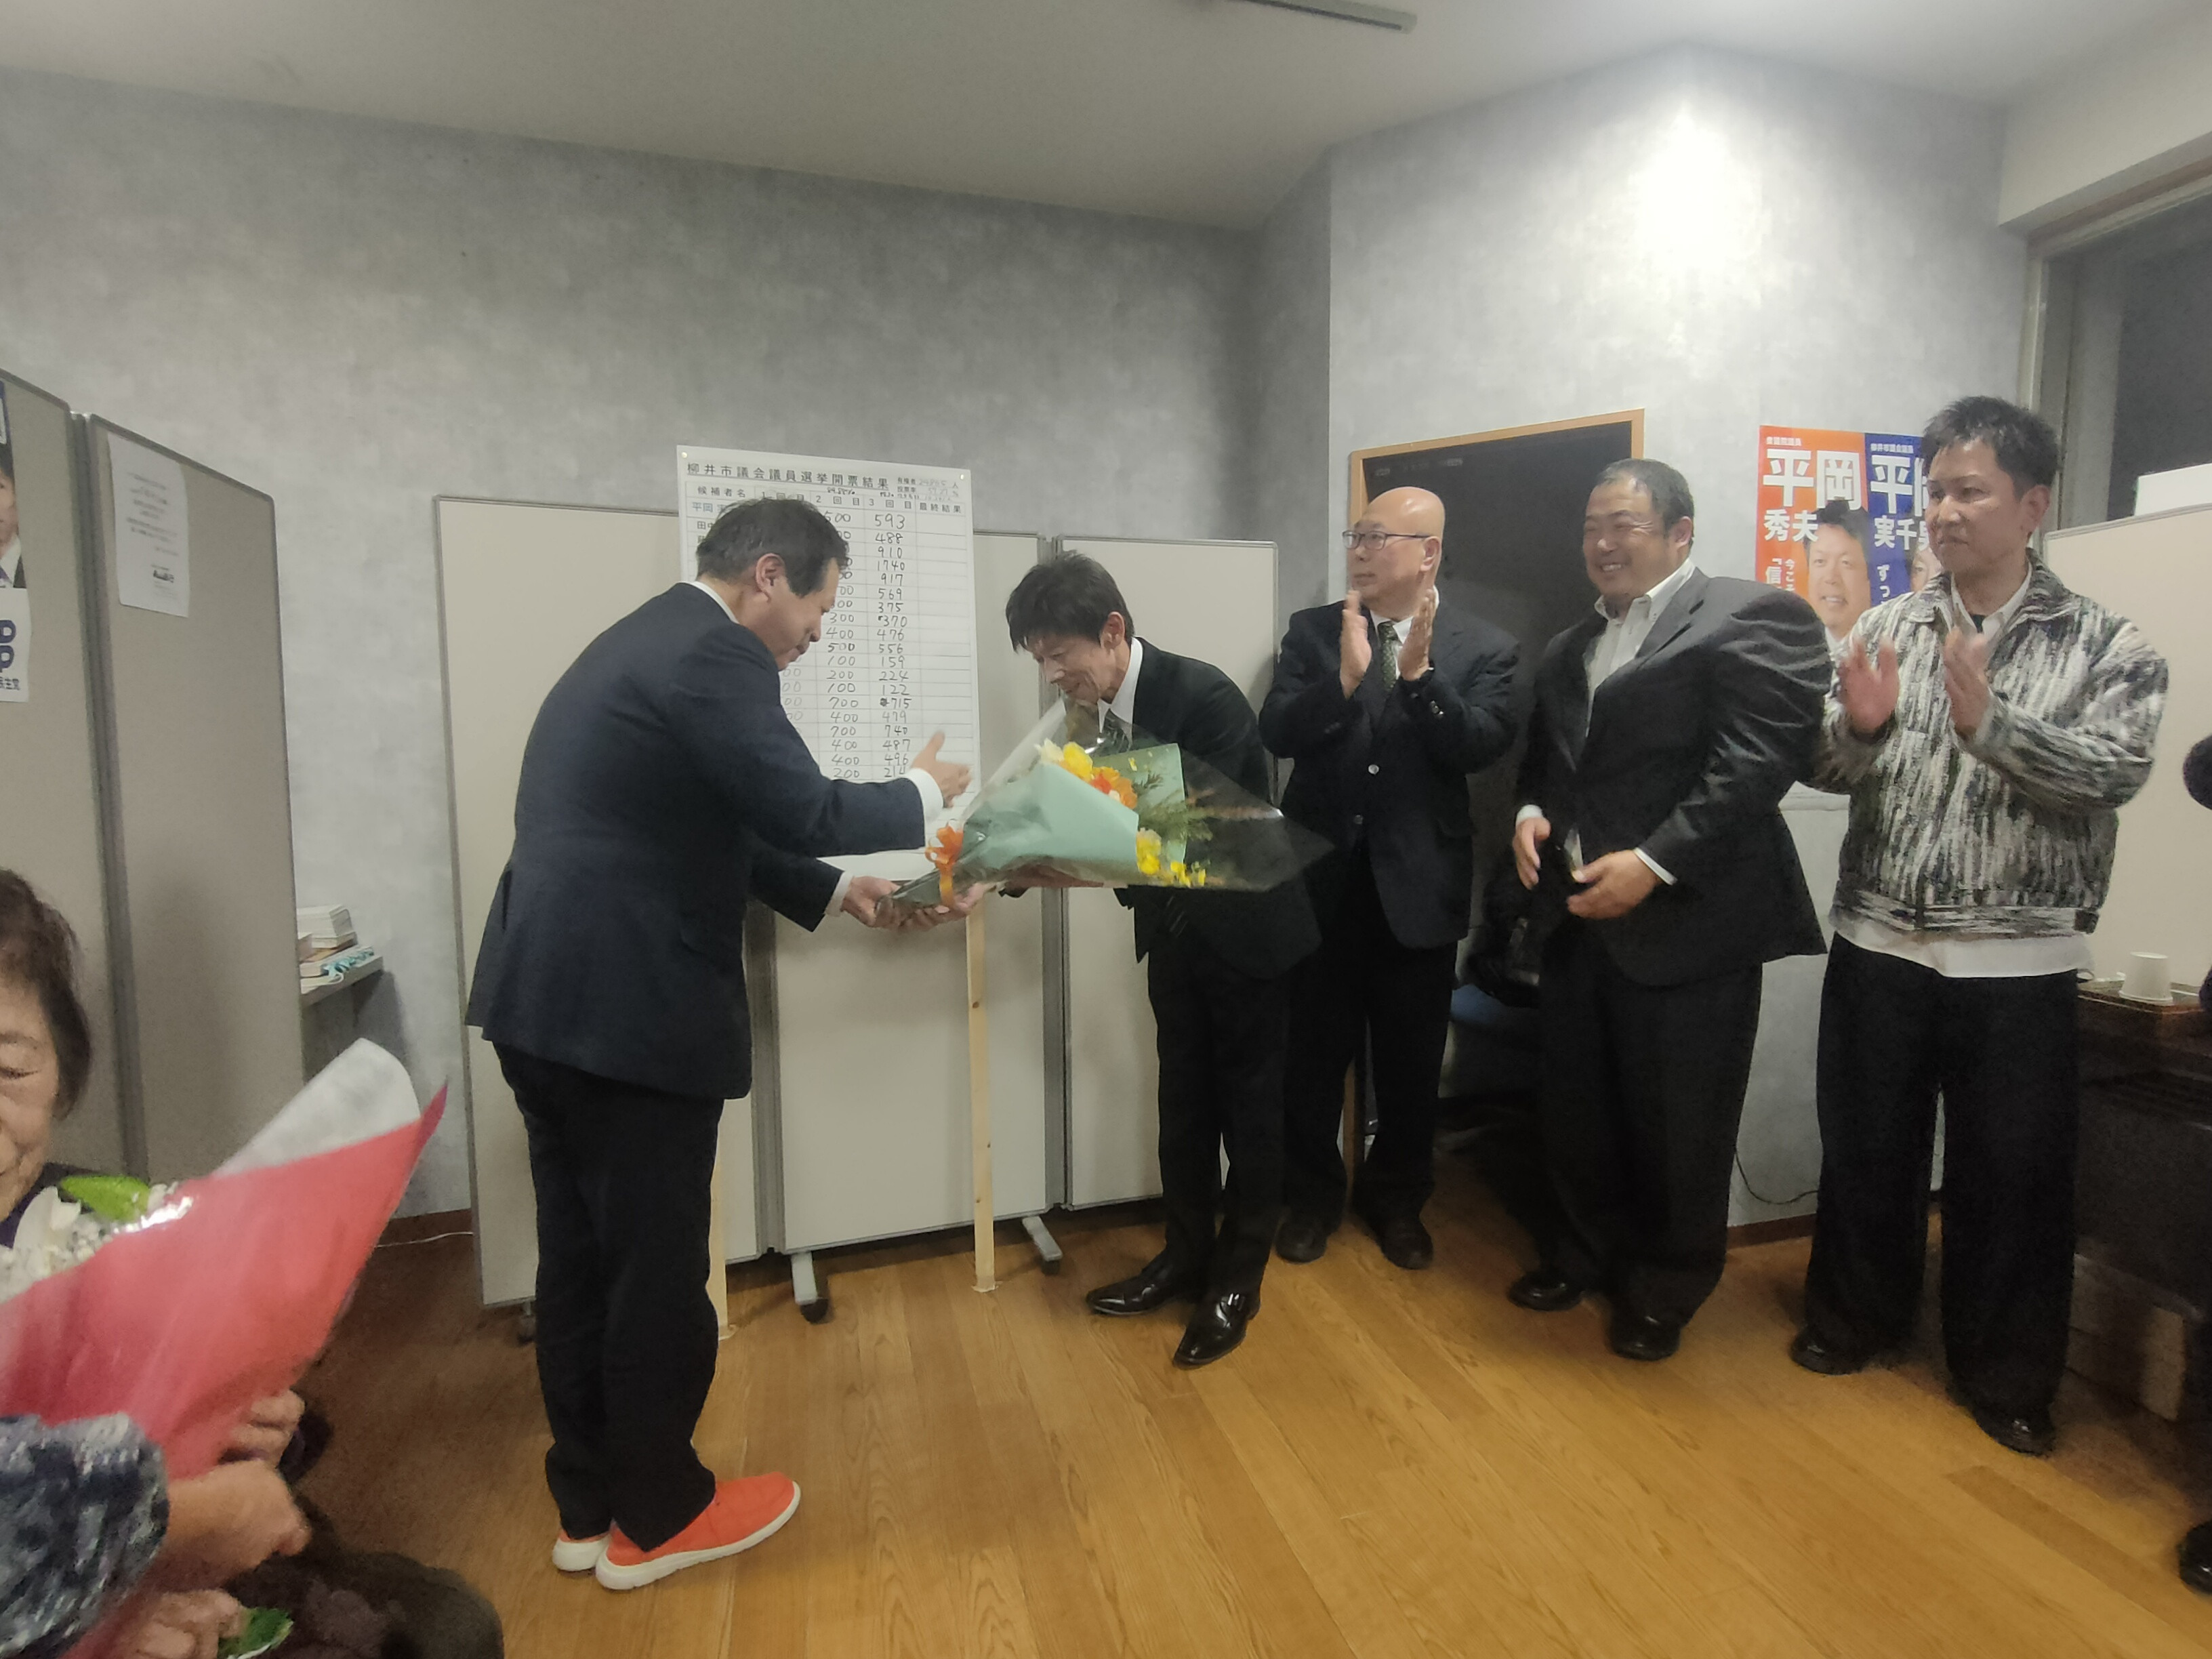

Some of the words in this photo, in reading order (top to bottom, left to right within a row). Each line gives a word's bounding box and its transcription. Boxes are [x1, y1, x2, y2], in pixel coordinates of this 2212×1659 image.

[1763, 449, 1862, 510] 平岡
[697, 486, 745, 498] 候補者名
[815, 495, 859, 506] 2回目
[868, 499, 912, 509] 3回目
[920, 503, 961, 514] 最終結果
[875, 514, 905, 529] 593
[1763, 509, 1819, 542] 秀夫
[875, 532, 903, 544] 488
[878, 546, 903, 558] 910
[877, 559, 905, 571] 1740
[1765, 558, 1782, 588] 「信
[881, 573, 903, 586] 917
[878, 588, 902, 600] 569
[878, 602, 903, 613] 375
[830, 612, 854, 623] 300
[826, 627, 854, 640] 400
[876, 627, 904, 641] 476
[827, 643, 855, 653] 500
[878, 644, 903, 653] 556
[828, 655, 855, 666] 100
[882, 655, 905, 668] 159
[826, 670, 854, 680] 200
[879, 671, 909, 680] 224
[828, 682, 856, 693] 100
[882, 684, 909, 695] 122
[829, 697, 858, 709] 700
[830, 712, 858, 722] 400
[882, 712, 907, 723] 479
[830, 726, 856, 737] 700
[884, 724, 908, 736] 740
[832, 739, 857, 752] 400
[882, 739, 910, 752] 487
[832, 754, 859, 766] 400
[884, 753, 909, 766] 496
[833, 768, 859, 778] 200
